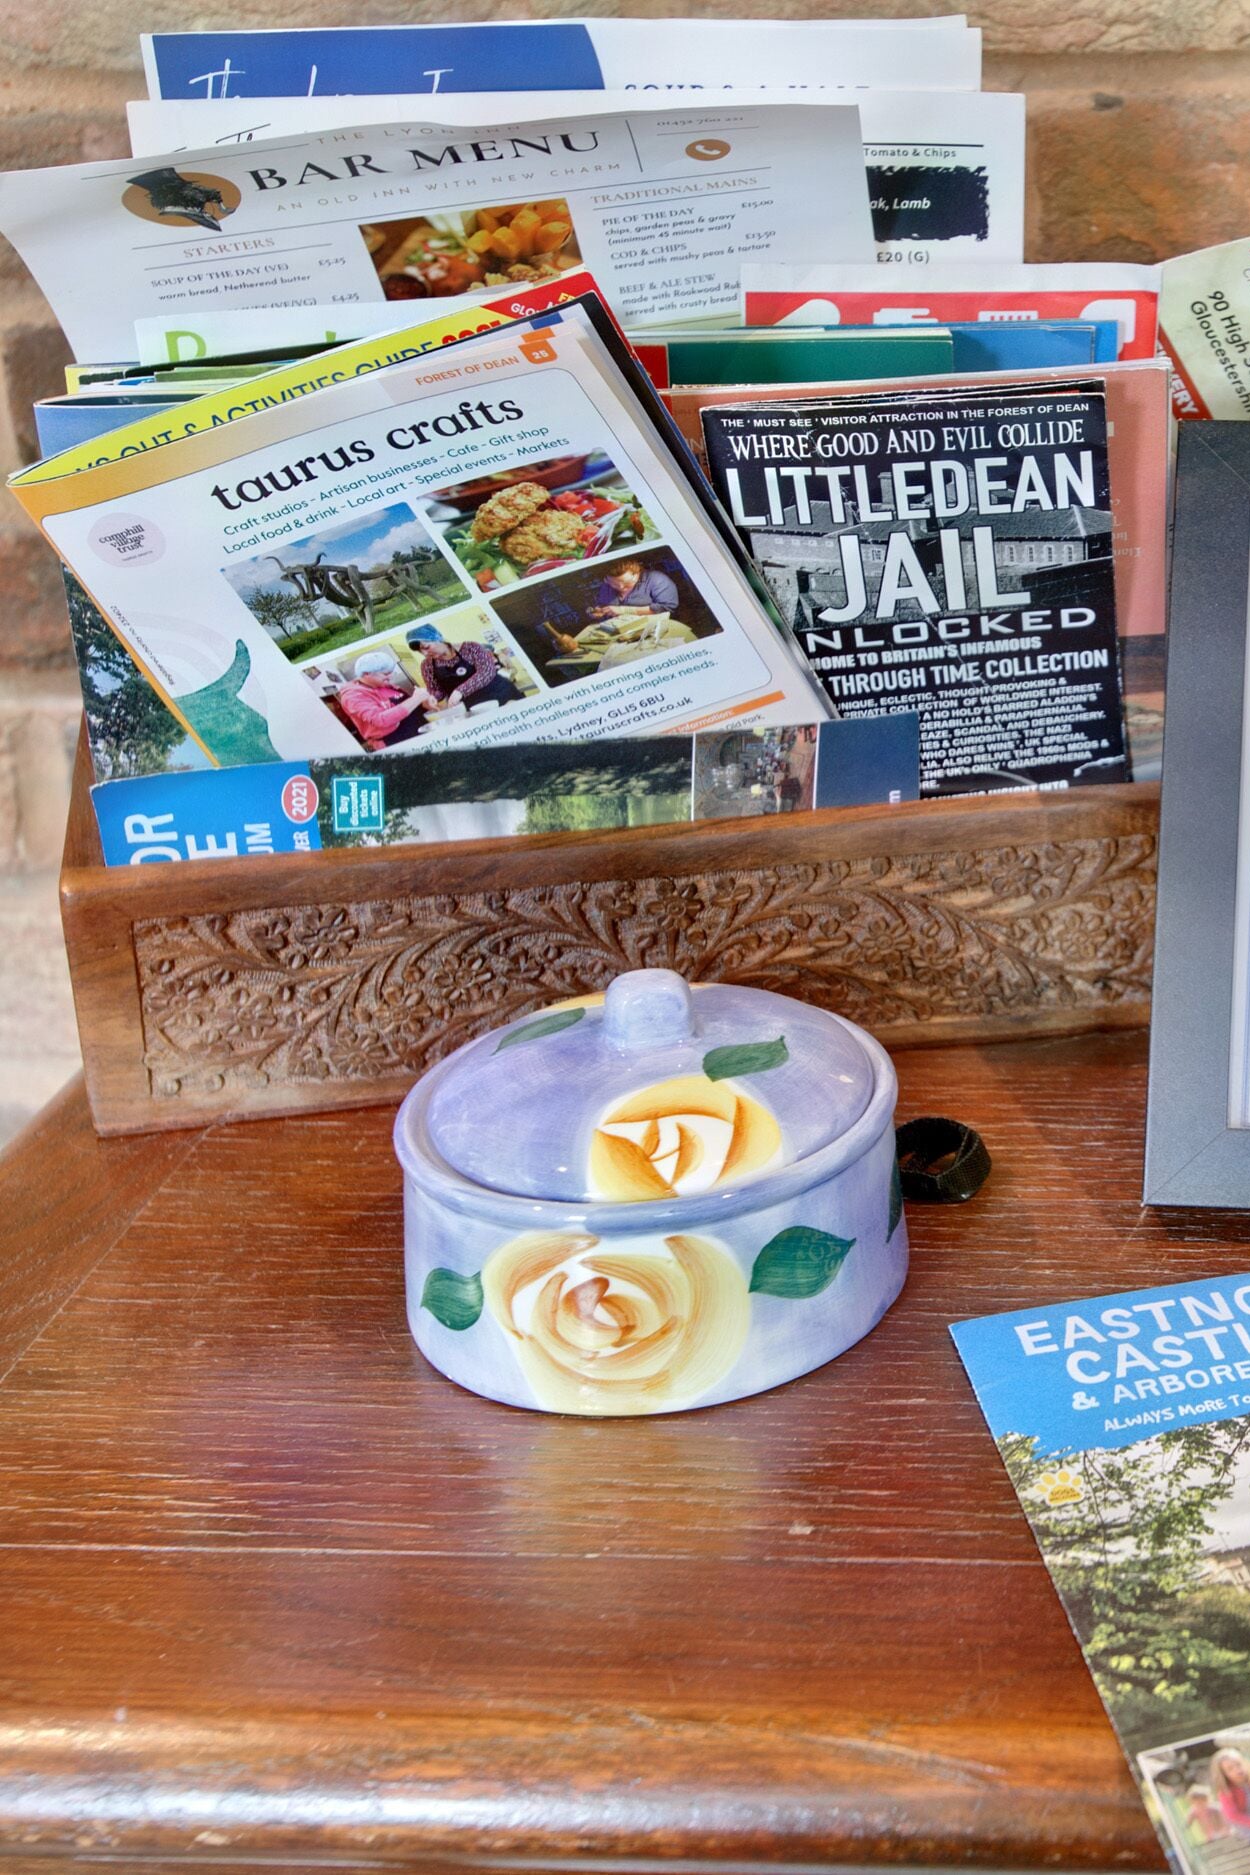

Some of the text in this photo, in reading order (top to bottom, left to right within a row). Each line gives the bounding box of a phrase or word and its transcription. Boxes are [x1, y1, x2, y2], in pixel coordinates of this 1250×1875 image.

[246, 130, 600, 192] BAR MENU
[864, 148, 956, 158] Tomato & Chips
[276, 162, 622, 212] AN OLD INN WITH NEW CHARM
[590, 176, 758, 204] TRADITIONAL MAINS
[602, 207, 695, 226] PIE OF THE DAY
[893, 198, 930, 209] Lamb
[183, 237, 276, 259] STARTERS
[610, 243, 687, 260] COD & CHIPS
[877, 251, 930, 264] £20 (G)
[151, 263, 289, 288] SOUP OF THE DAY (VE)
[1208, 290, 1229, 312] 90
[1220, 314, 1250, 354] High
[532, 350, 549, 360] 25
[416, 356, 520, 386] FOREST OF DEAN
[721, 403, 1089, 427] THE MUST SEE VISITOR ATTRACTION IN THE FOREST OF DEAN
[727, 419, 1085, 461] WHERE GOOD AND EVIL COLLIDE
[211, 400, 524, 510] taurus crafts
[223, 426, 549, 536] Craft studios Artisan businesses Cafe Gift shop
[726, 450, 1095, 527] LITTLEDEAN
[223, 437, 569, 554] Local food & drink Local art Special events Markets
[99, 524, 145, 543] camphill
[111, 534, 145, 548] village
[117, 541, 144, 553] trust
[817, 526, 1031, 623] JAIL
[806, 607, 1097, 653] NLOCKED
[857, 652, 879, 667] TO
[881, 645, 958, 664] BRITAIN'S
[960, 636, 1042, 655] INFAMOUS
[828, 649, 1108, 697] THROUGH TIME COLLECTION
[292, 782, 307, 816] 2021
[339, 795, 350, 814] Buy
[349, 782, 358, 826] discounted
[360, 789, 368, 818] tickets
[370, 790, 378, 816] online
[1071, 1391, 1100, 1411] &
[1103, 1406, 1176, 1432] ALWAYS
